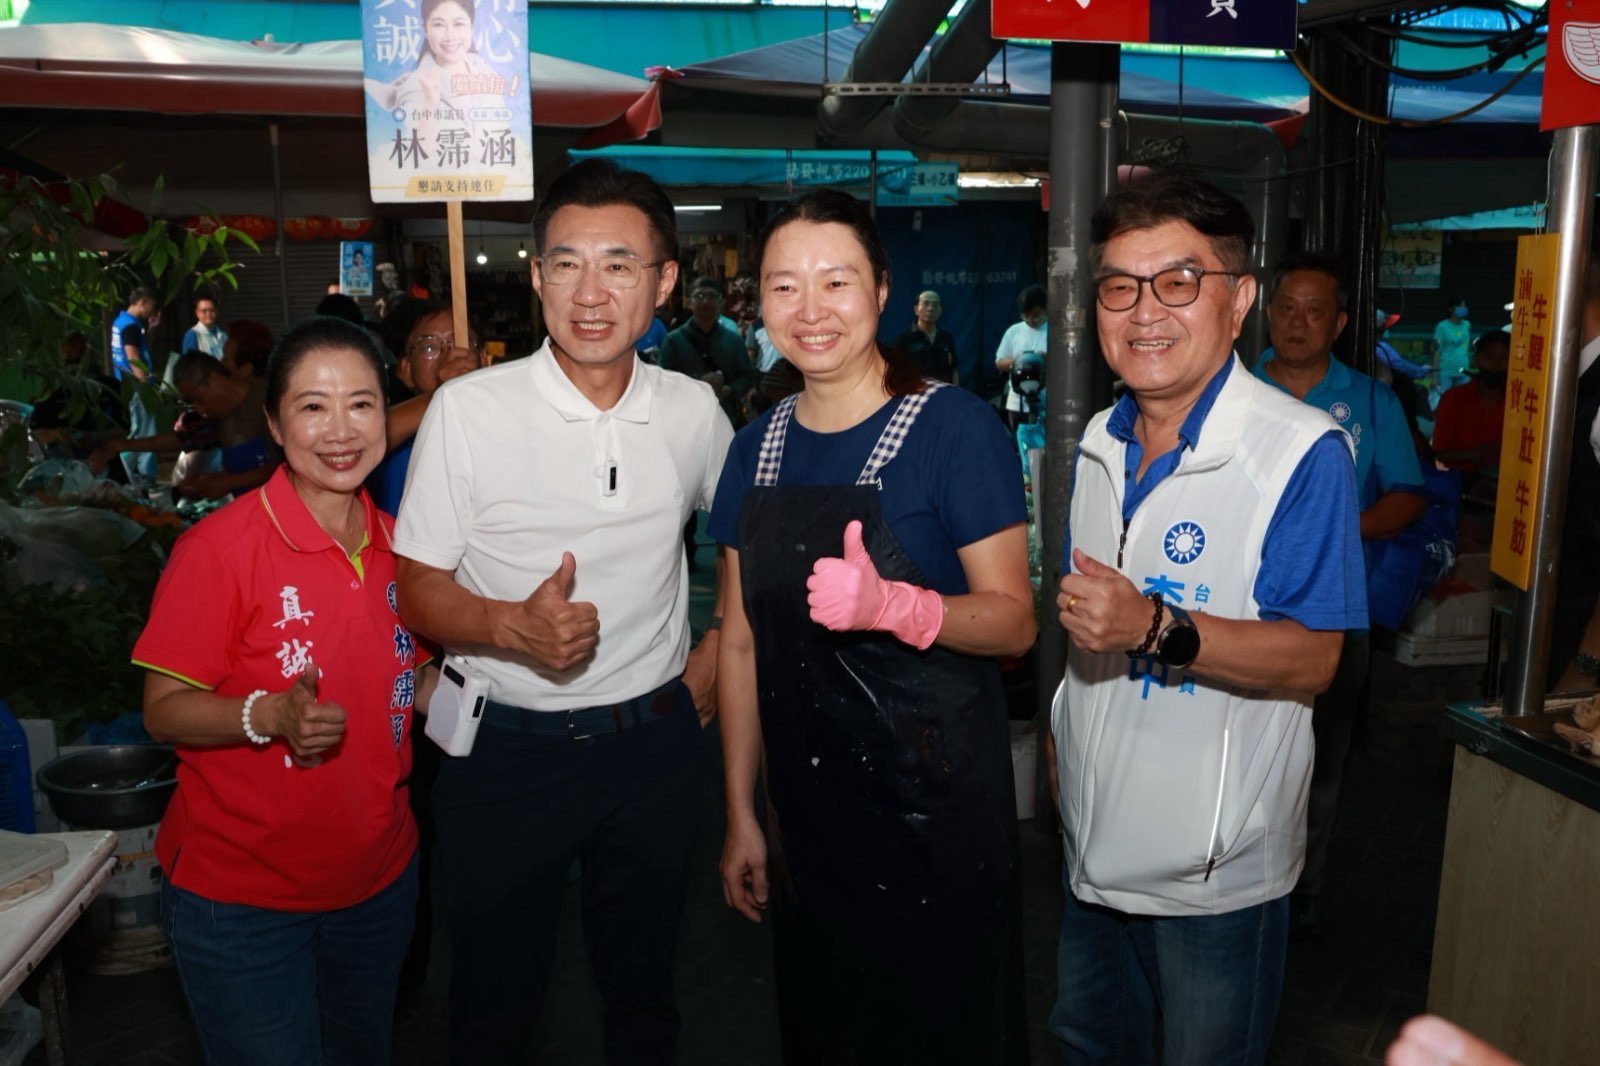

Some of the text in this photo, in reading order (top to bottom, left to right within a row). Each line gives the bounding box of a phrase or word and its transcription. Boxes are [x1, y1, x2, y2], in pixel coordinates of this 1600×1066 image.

[373, 0, 422, 65] 誠
[475, 0, 521, 63] 心
[411, 109, 465, 121] 台中市議員
[389, 127, 516, 169] 林霈涵
[417, 179, 495, 193] 懇請支持連任
